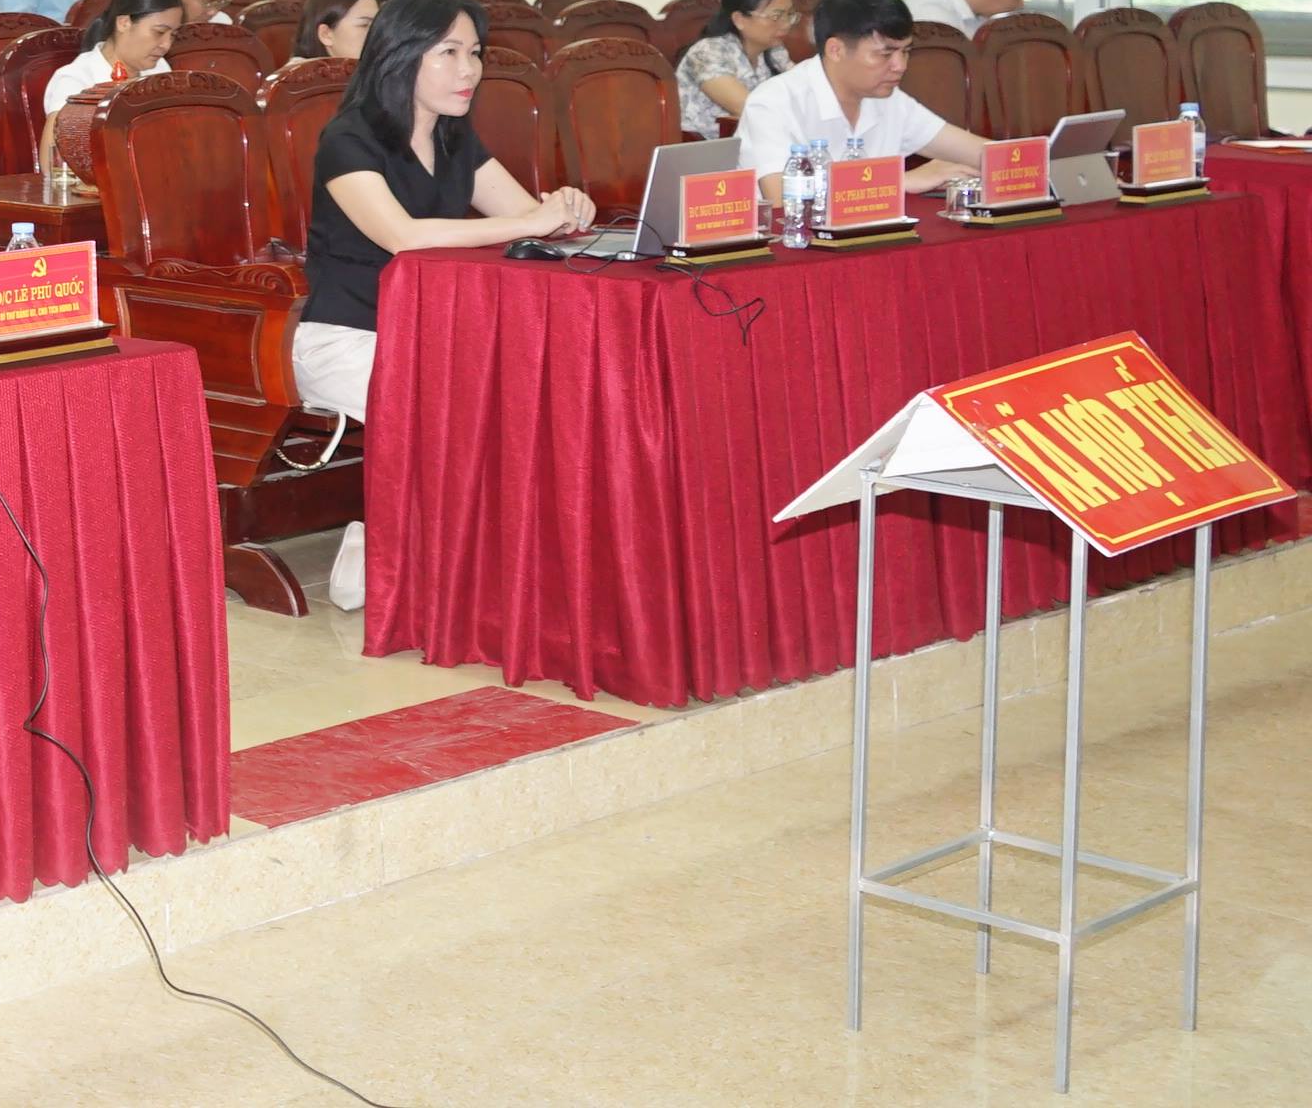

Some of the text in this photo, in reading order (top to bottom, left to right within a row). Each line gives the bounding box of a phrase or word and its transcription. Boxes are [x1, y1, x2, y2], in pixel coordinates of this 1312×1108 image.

[14, 283, 29, 303] LÊ
[30, 280, 52, 301] PHÚ
[54, 275, 84, 298] QUỐC
[987, 355, 1247, 513] XÃ HỢP TIẾN
